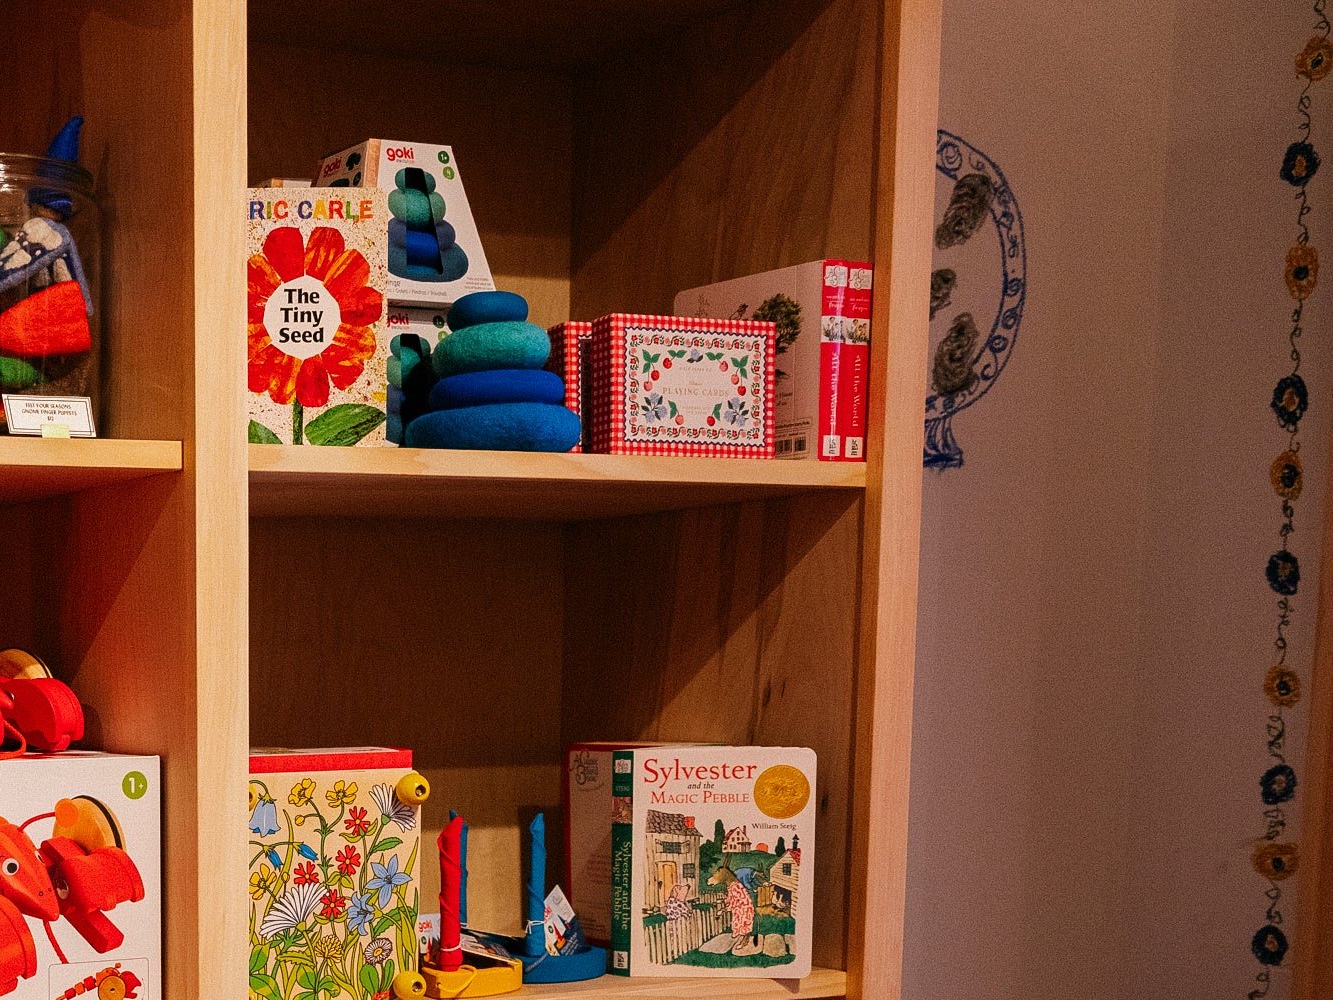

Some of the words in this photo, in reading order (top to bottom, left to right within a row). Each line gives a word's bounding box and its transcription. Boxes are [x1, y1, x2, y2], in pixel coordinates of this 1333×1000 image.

[386, 147, 414, 161] goki
[248, 200, 289, 220] RIC
[297, 200, 374, 219] CARLE
[284, 288, 320, 304] The
[281, 307, 324, 328] Tiny
[279, 328, 324, 343] Seed
[662, 387, 698, 396] PLAYING
[702, 389, 729, 397] CARDS
[644, 758, 757, 789] Sylvester
[128, 776, 144, 793] 1+
[651, 791, 698, 804] MAGIC
[703, 791, 750, 804] PEBBLE
[780, 823, 797, 831] Steig
[612, 850, 623, 883] Magic
[621, 841, 632, 888] Sylvester
[614, 886, 623, 920] Pebble
[622, 888, 631, 906] and
[622, 907, 630, 930] the
